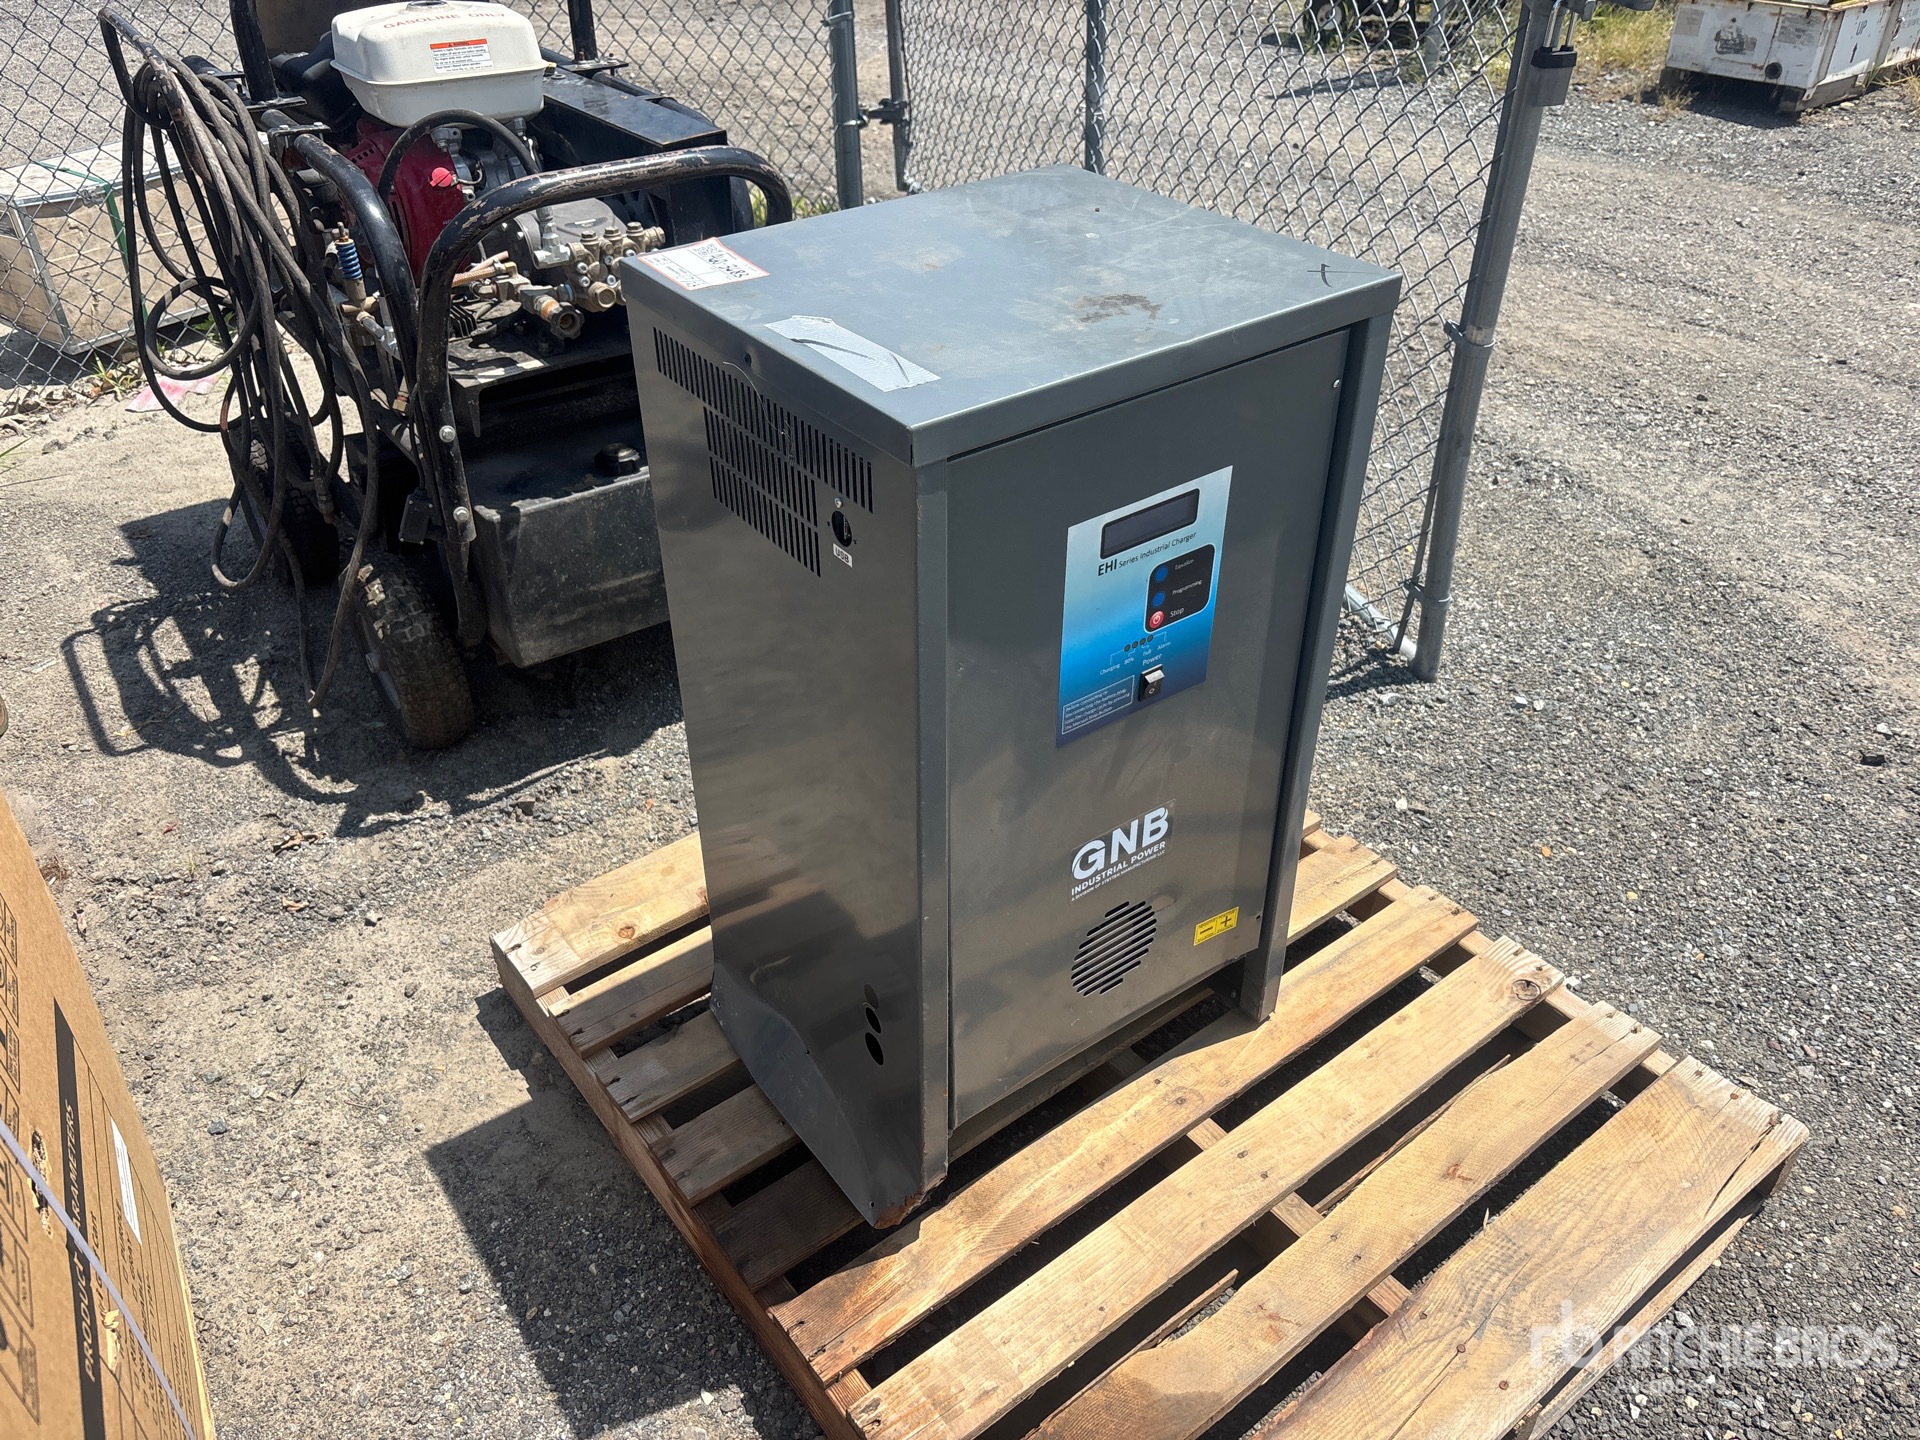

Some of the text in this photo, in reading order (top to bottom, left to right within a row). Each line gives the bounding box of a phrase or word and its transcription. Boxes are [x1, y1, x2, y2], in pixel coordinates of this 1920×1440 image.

[384, 11, 505, 29] GASOLINE ONLY
[1856, 20, 1868, 36] UP
[835, 547, 849, 563] USB
[1098, 532, 1197, 576] EHI Series Industrial Charger
[1170, 607, 1185, 618] Stop
[1142, 654, 1163, 666] Power
[1072, 806, 1169, 880] GNB
[1071, 841, 1166, 896] INDUSTRIAL POWER
[91, 1210, 99, 1250] Cart
[74, 1251, 96, 1383] PRODUCT
